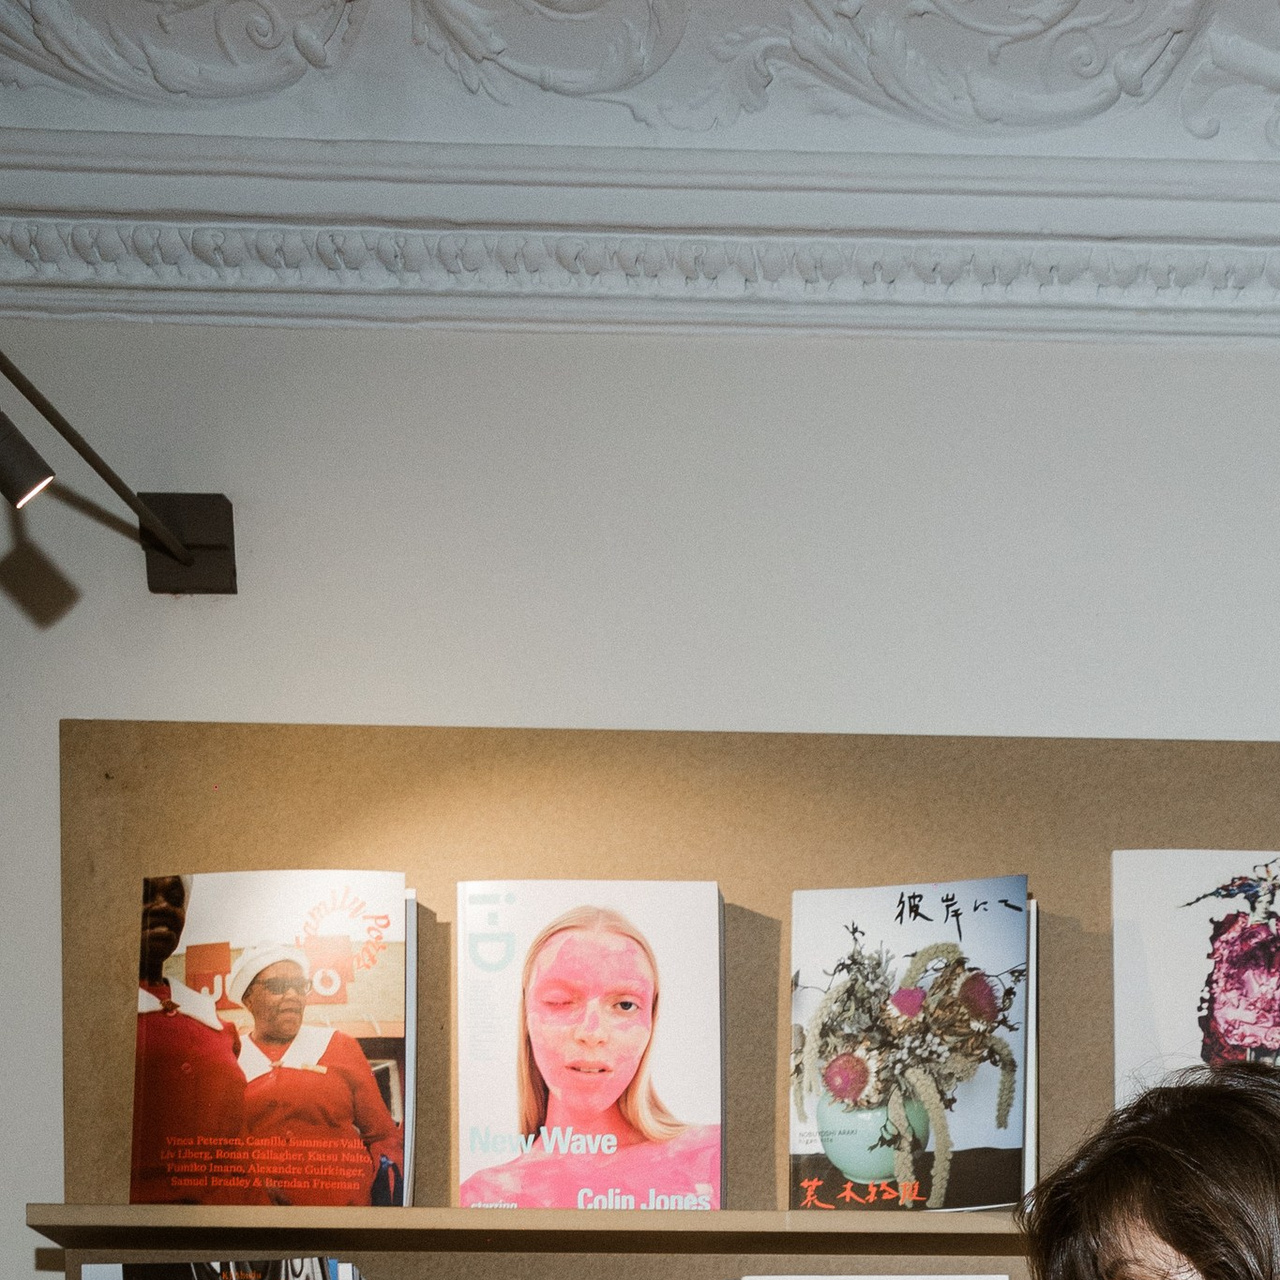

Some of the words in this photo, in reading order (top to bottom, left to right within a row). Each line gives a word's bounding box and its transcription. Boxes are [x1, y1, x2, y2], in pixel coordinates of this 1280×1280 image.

[468, 1126, 536, 1151] New
[540, 1126, 618, 1154] Wave
[252, 1177, 263, 1188] &
[577, 1188, 635, 1210] Colin
[640, 1188, 712, 1211] Jones
